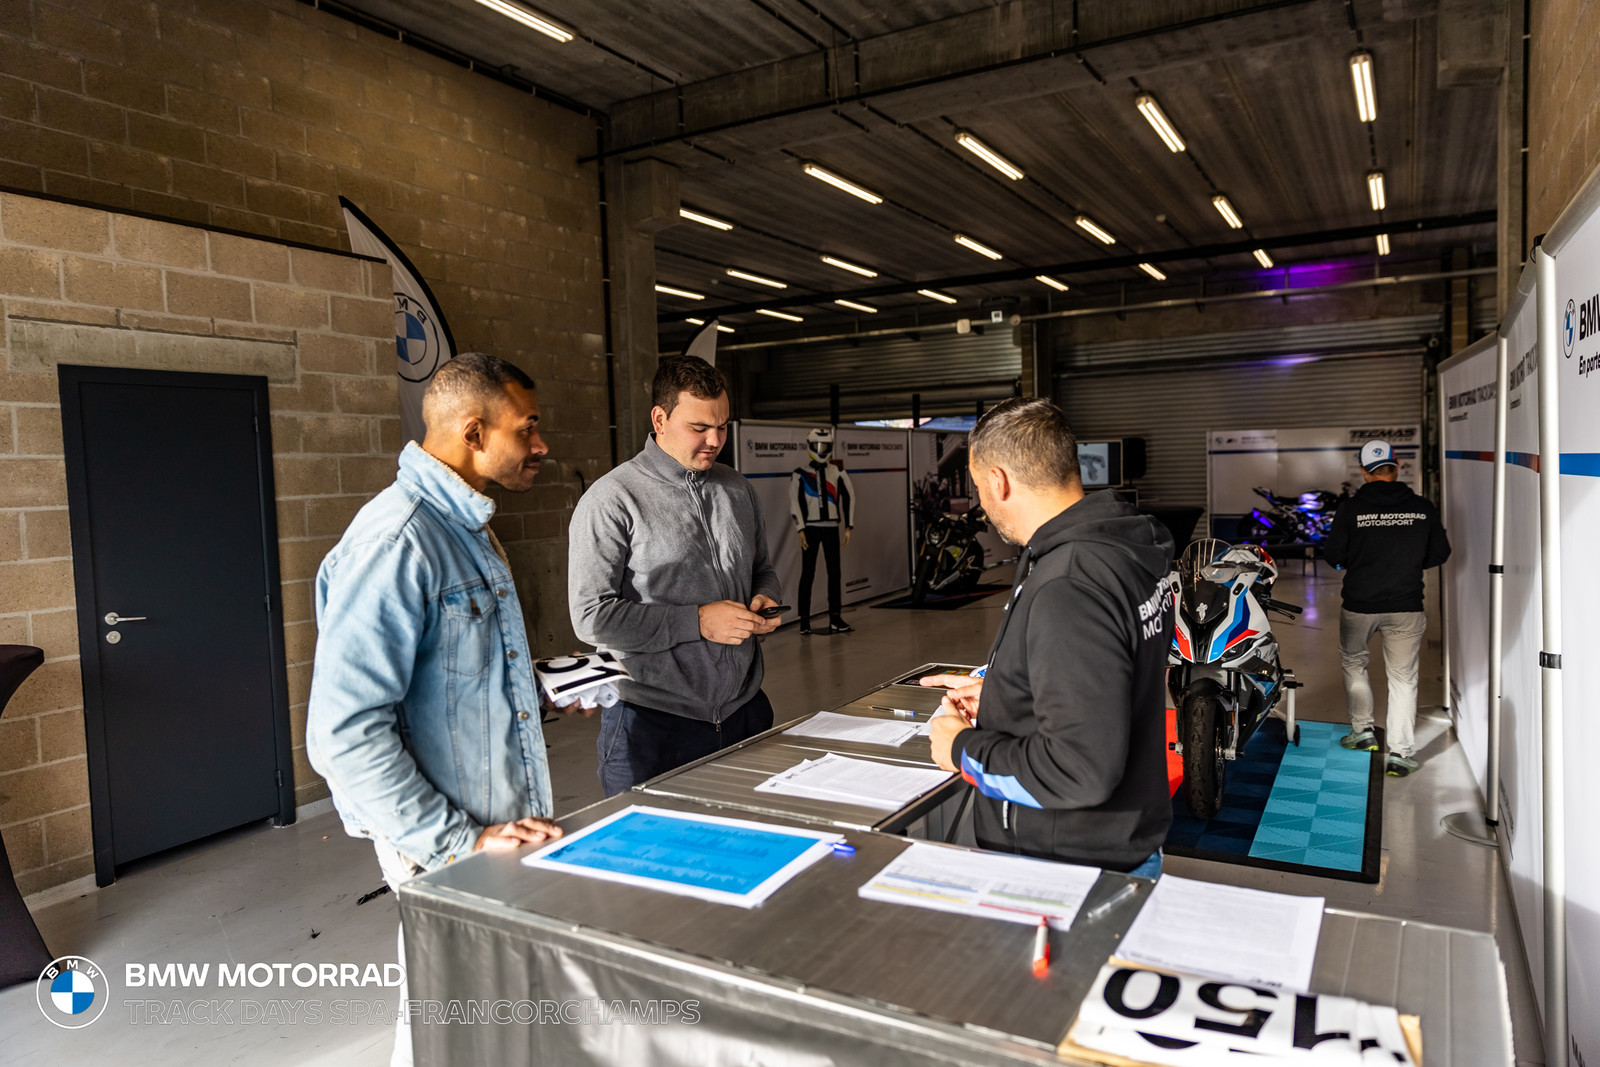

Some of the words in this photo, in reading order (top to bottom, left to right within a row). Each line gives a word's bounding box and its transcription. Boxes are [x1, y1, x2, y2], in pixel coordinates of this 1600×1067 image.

[1349, 428, 1417, 438] TECMAS
[755, 442, 768, 451] BMW
[769, 442, 798, 451] MOTORRAD
[1356, 519, 1414, 528] MOTORSPORT
